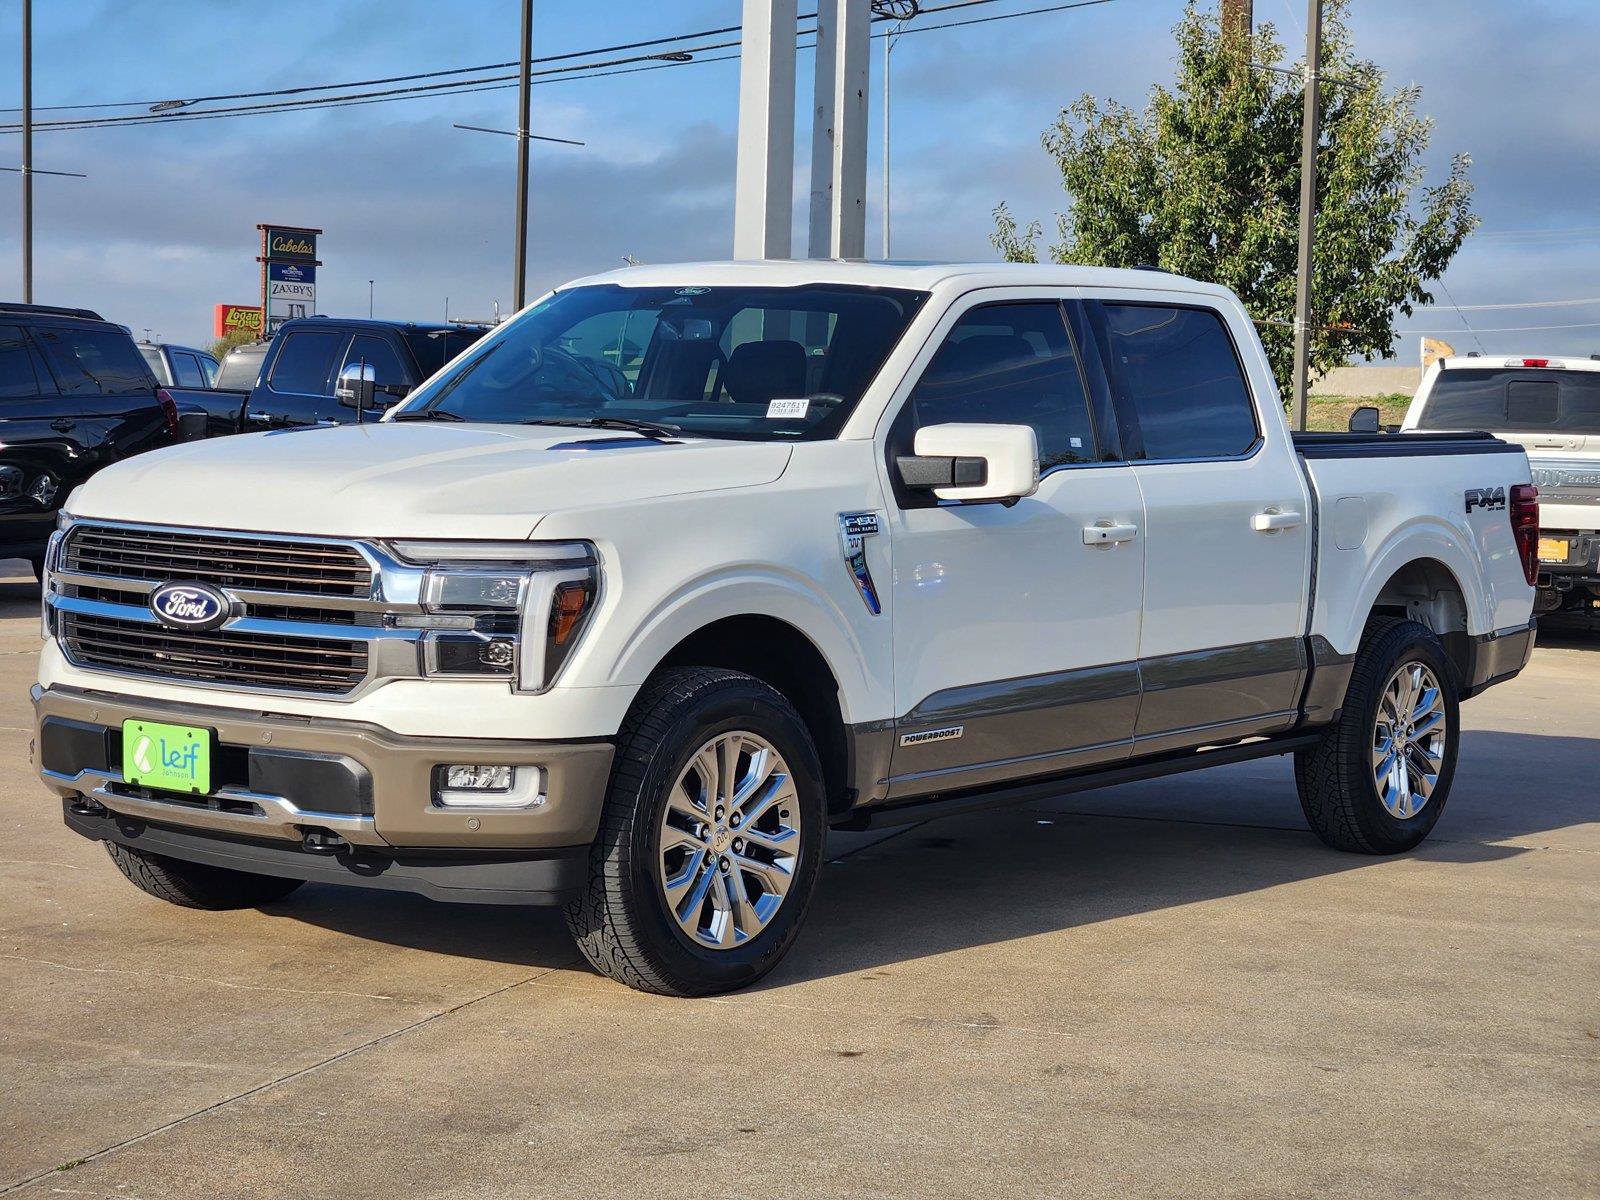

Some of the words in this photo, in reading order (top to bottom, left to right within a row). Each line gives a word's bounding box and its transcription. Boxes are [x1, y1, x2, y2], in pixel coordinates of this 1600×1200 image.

[272, 237, 313, 254] Cabela's
[272, 284, 313, 298] ZAXBY'S
[225, 308, 262, 329] Logan
[1464, 487, 1506, 514] FX4
[165, 591, 209, 618] Ford
[904, 729, 961, 743] POWERBOOST
[160, 738, 201, 780] leif
[162, 768, 189, 779] Johnson
